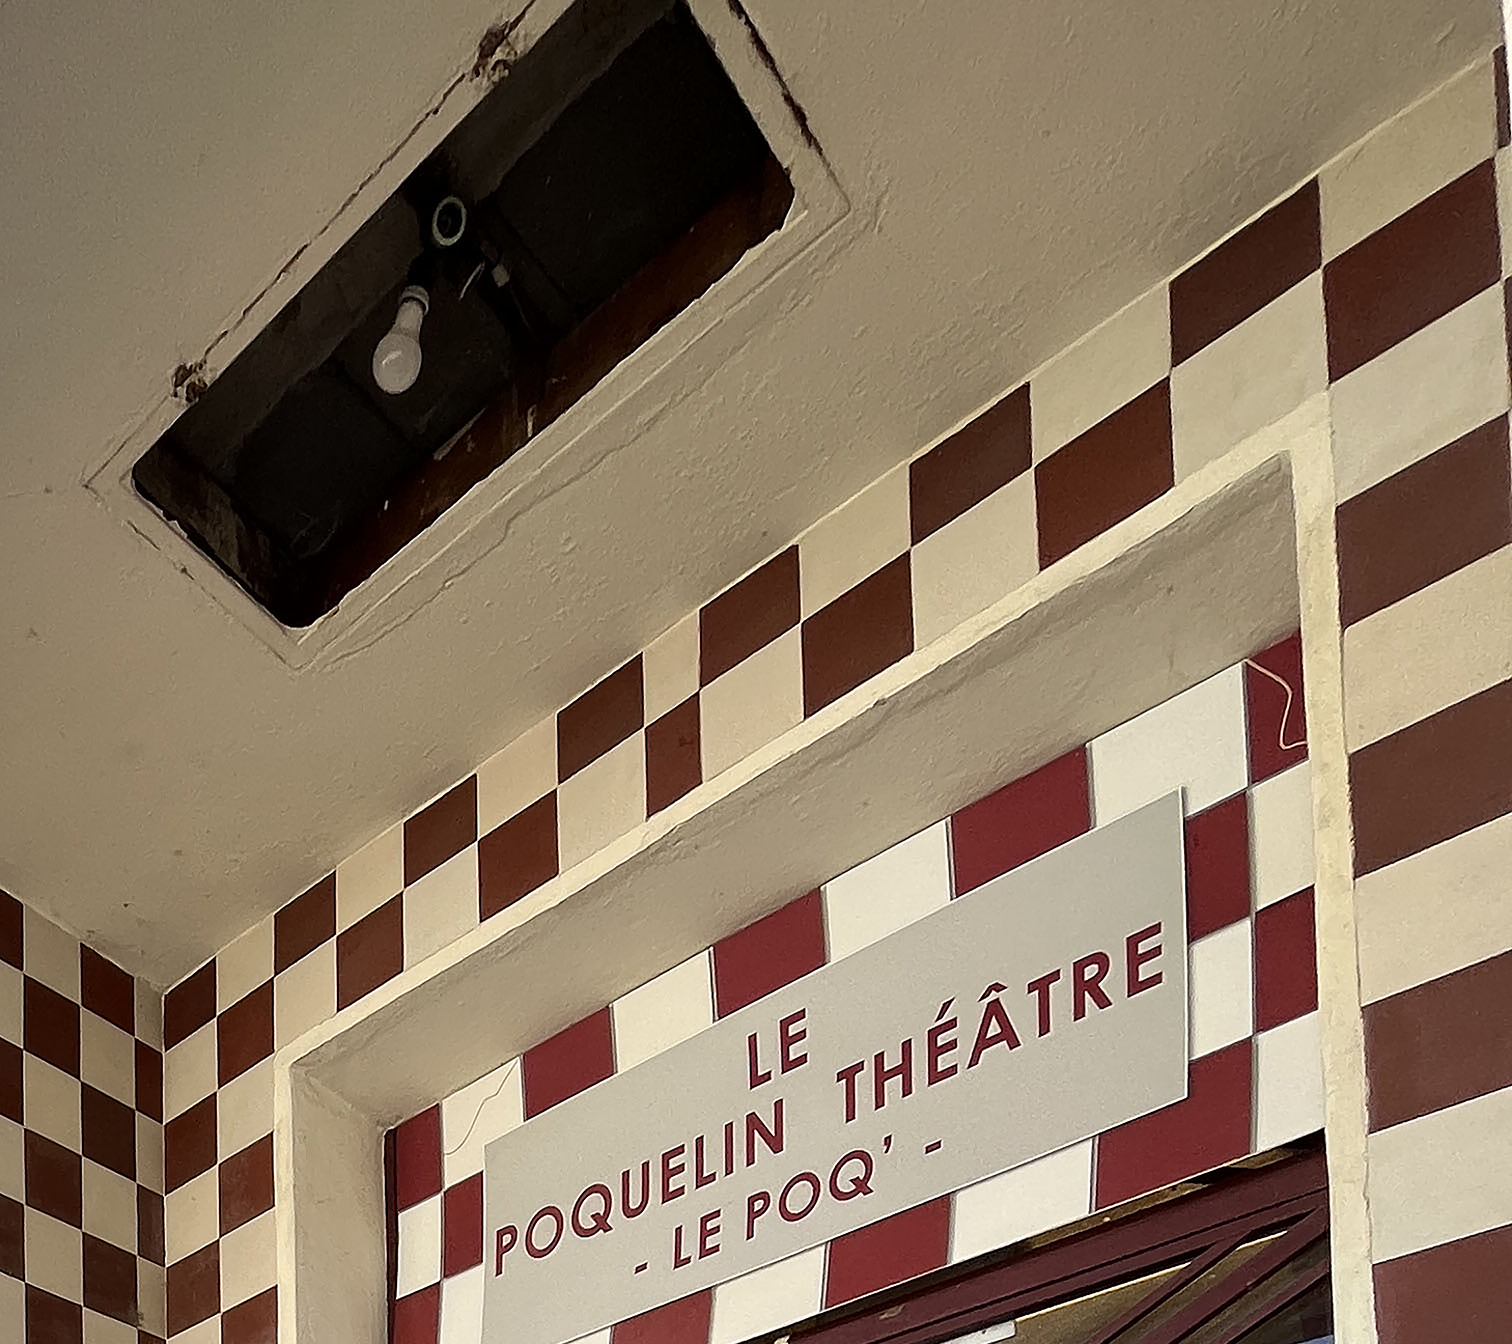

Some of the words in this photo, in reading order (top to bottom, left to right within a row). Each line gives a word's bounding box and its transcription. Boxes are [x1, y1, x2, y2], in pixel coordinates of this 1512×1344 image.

[746, 1008, 809, 1091] LE
[493, 1099, 786, 1277] POQUELIN
[835, 921, 1165, 1125] THÉÂTRE
[672, 1209, 722, 1271] LE
